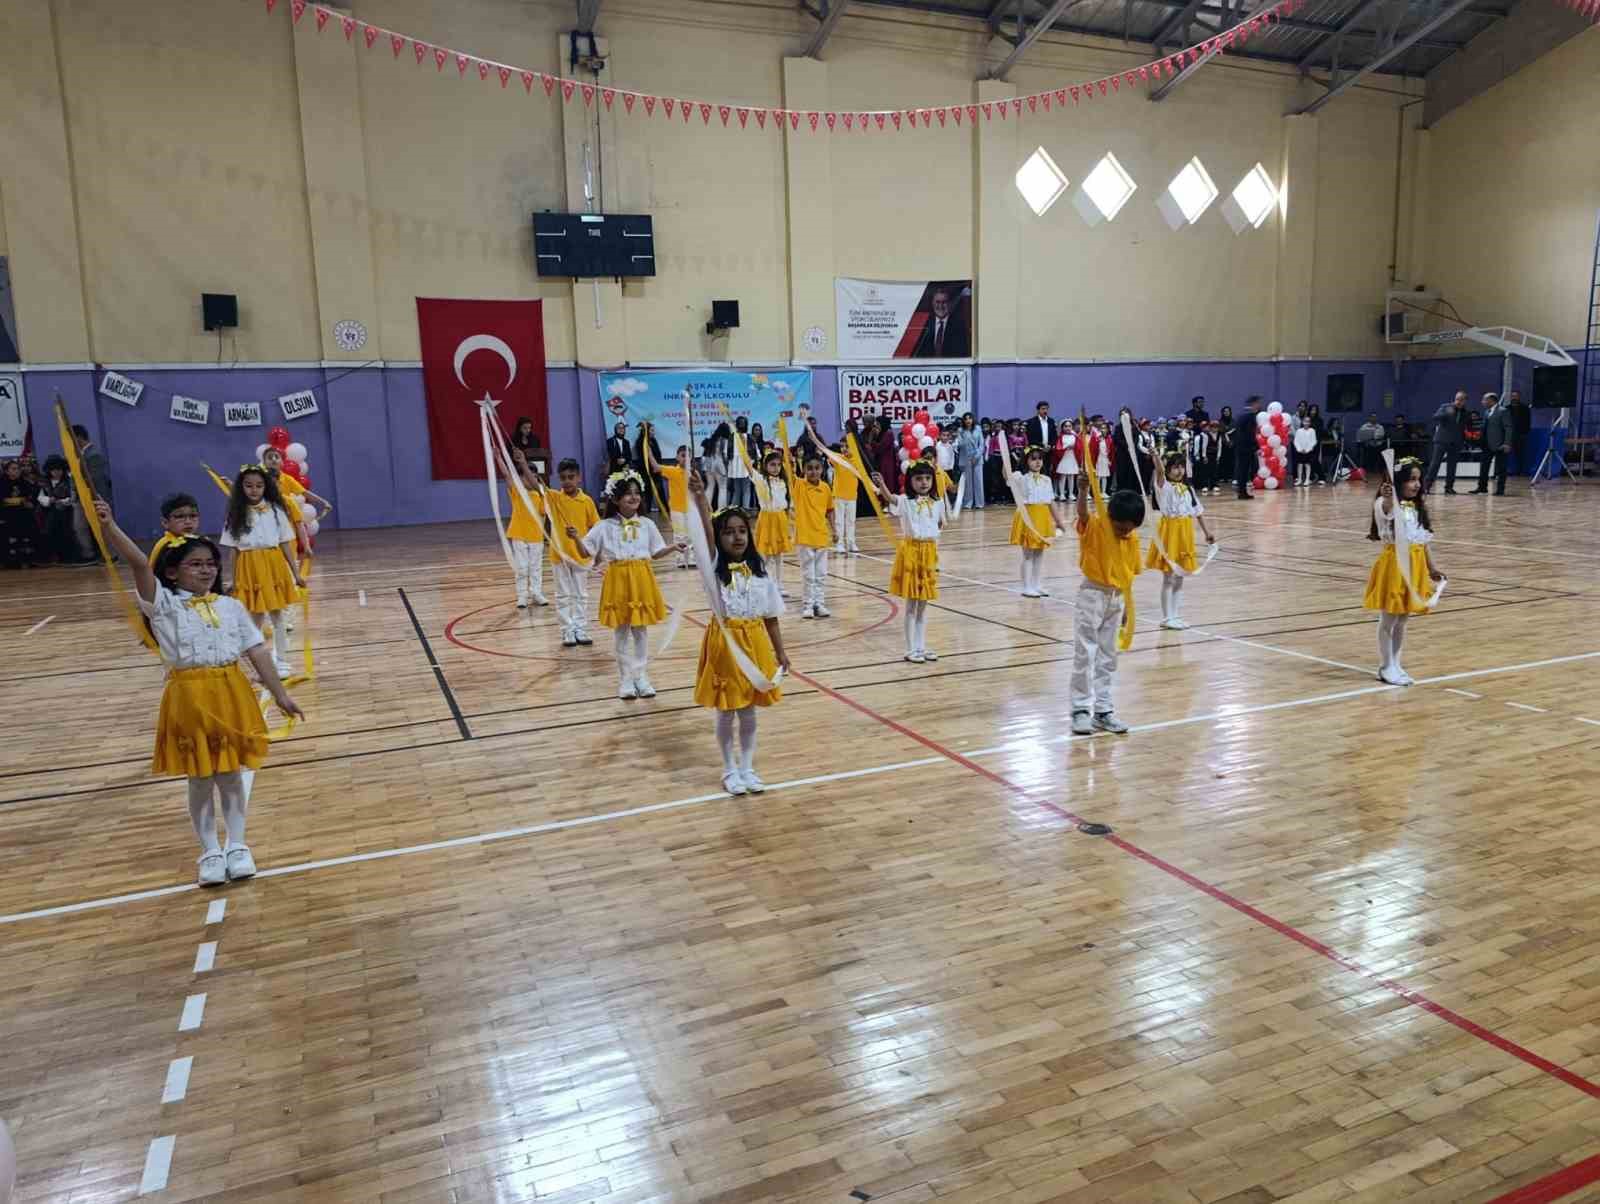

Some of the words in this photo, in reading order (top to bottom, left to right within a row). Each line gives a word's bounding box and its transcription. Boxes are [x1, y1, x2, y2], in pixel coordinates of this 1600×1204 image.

[848, 373, 875, 387] TÜM
[878, 374, 960, 387] SPORCULARA
[284, 394, 315, 415] OLSUN
[849, 388, 961, 406] BAŞARILAR
[228, 403, 258, 422] ARMAĞAN
